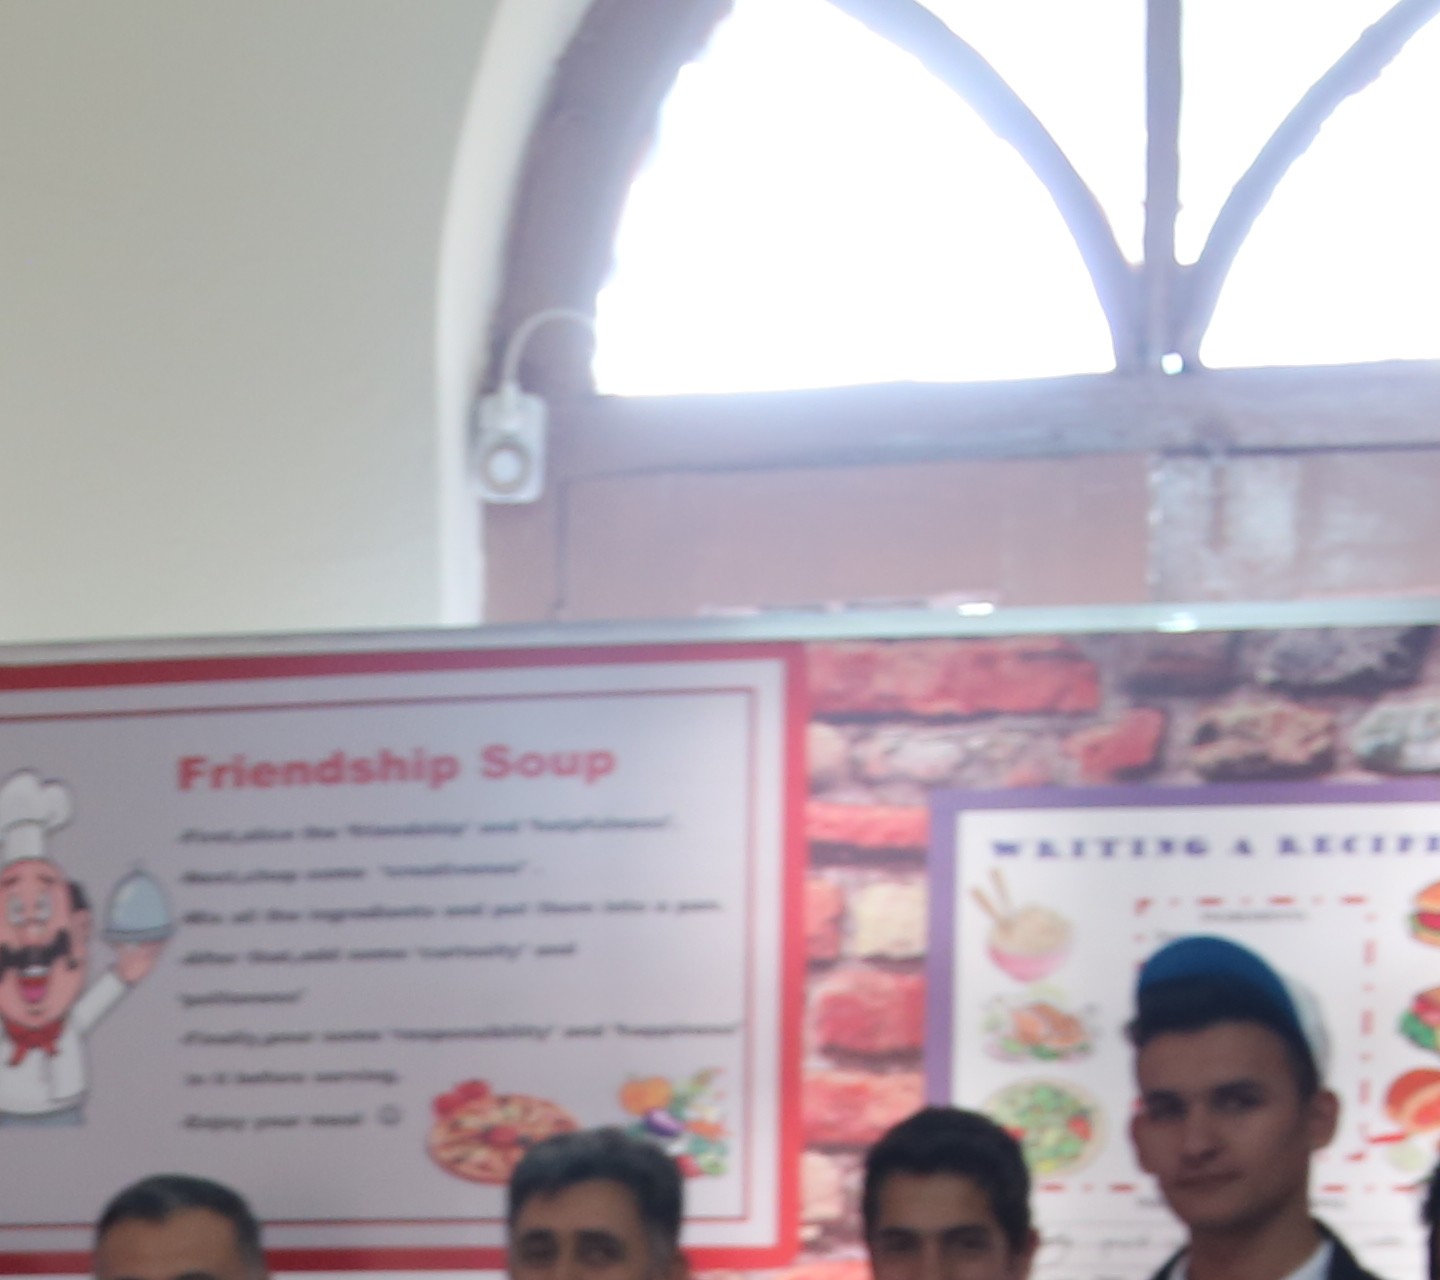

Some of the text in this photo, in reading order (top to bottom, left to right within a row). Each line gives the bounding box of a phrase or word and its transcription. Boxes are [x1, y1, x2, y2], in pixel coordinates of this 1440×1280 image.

[177, 743, 617, 791] Friendship Soup
[991, 837, 1210, 859] WRITING
[1231, 838, 1254, 857] A
